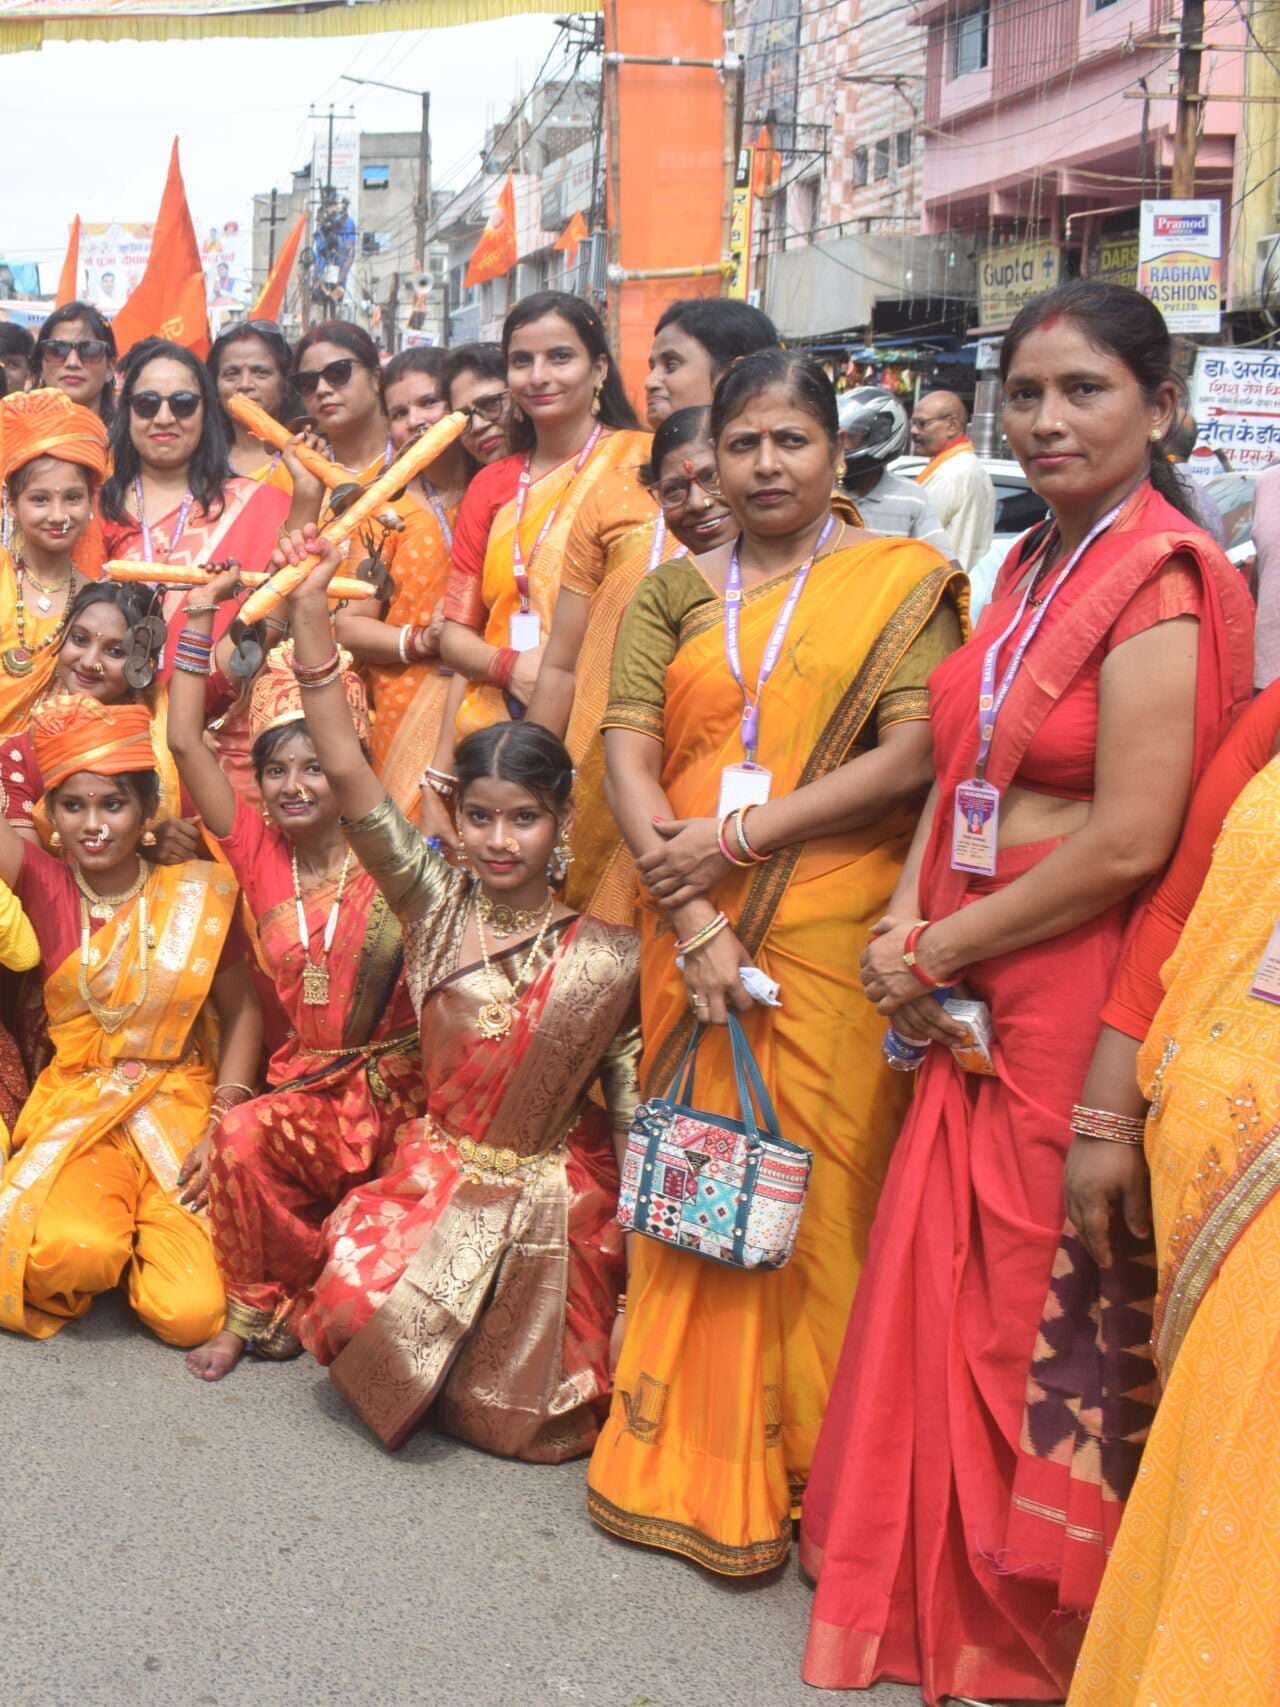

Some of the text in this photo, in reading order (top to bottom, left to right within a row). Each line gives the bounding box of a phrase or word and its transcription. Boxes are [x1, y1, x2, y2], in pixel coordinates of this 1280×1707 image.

[1157, 216, 1206, 230] Pramod
[983, 257, 1033, 289] Gupta
[1150, 266, 1212, 282] RAGHAV
[1143, 285, 1218, 302] FASHIONS
